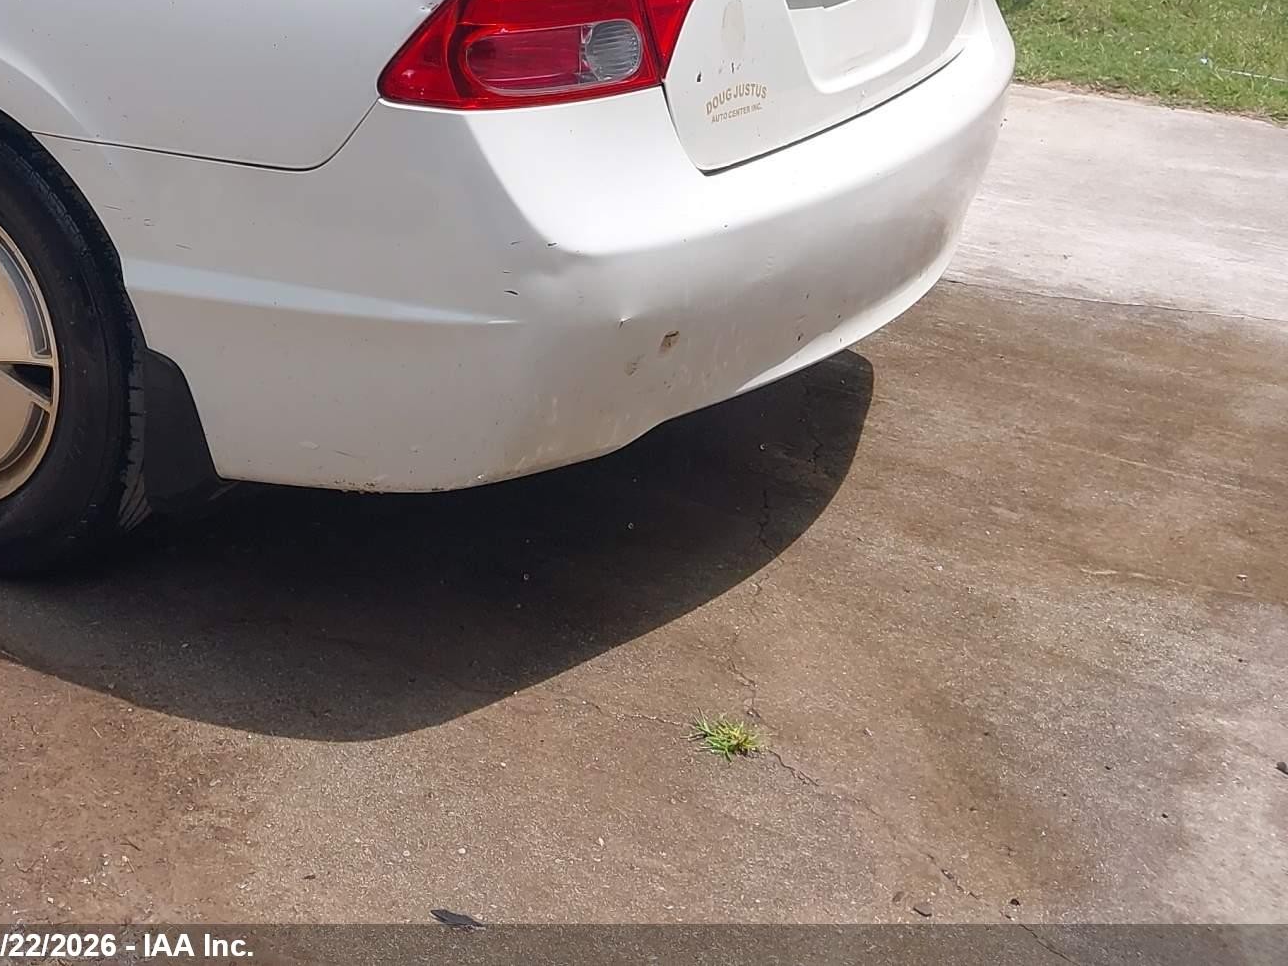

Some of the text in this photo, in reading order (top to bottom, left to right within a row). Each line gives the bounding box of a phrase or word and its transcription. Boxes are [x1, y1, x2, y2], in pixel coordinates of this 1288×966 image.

[705, 82, 768, 115] DOUG JUSTUS
[711, 112, 728, 123] AUTO
[728, 104, 751, 119] CENTER
